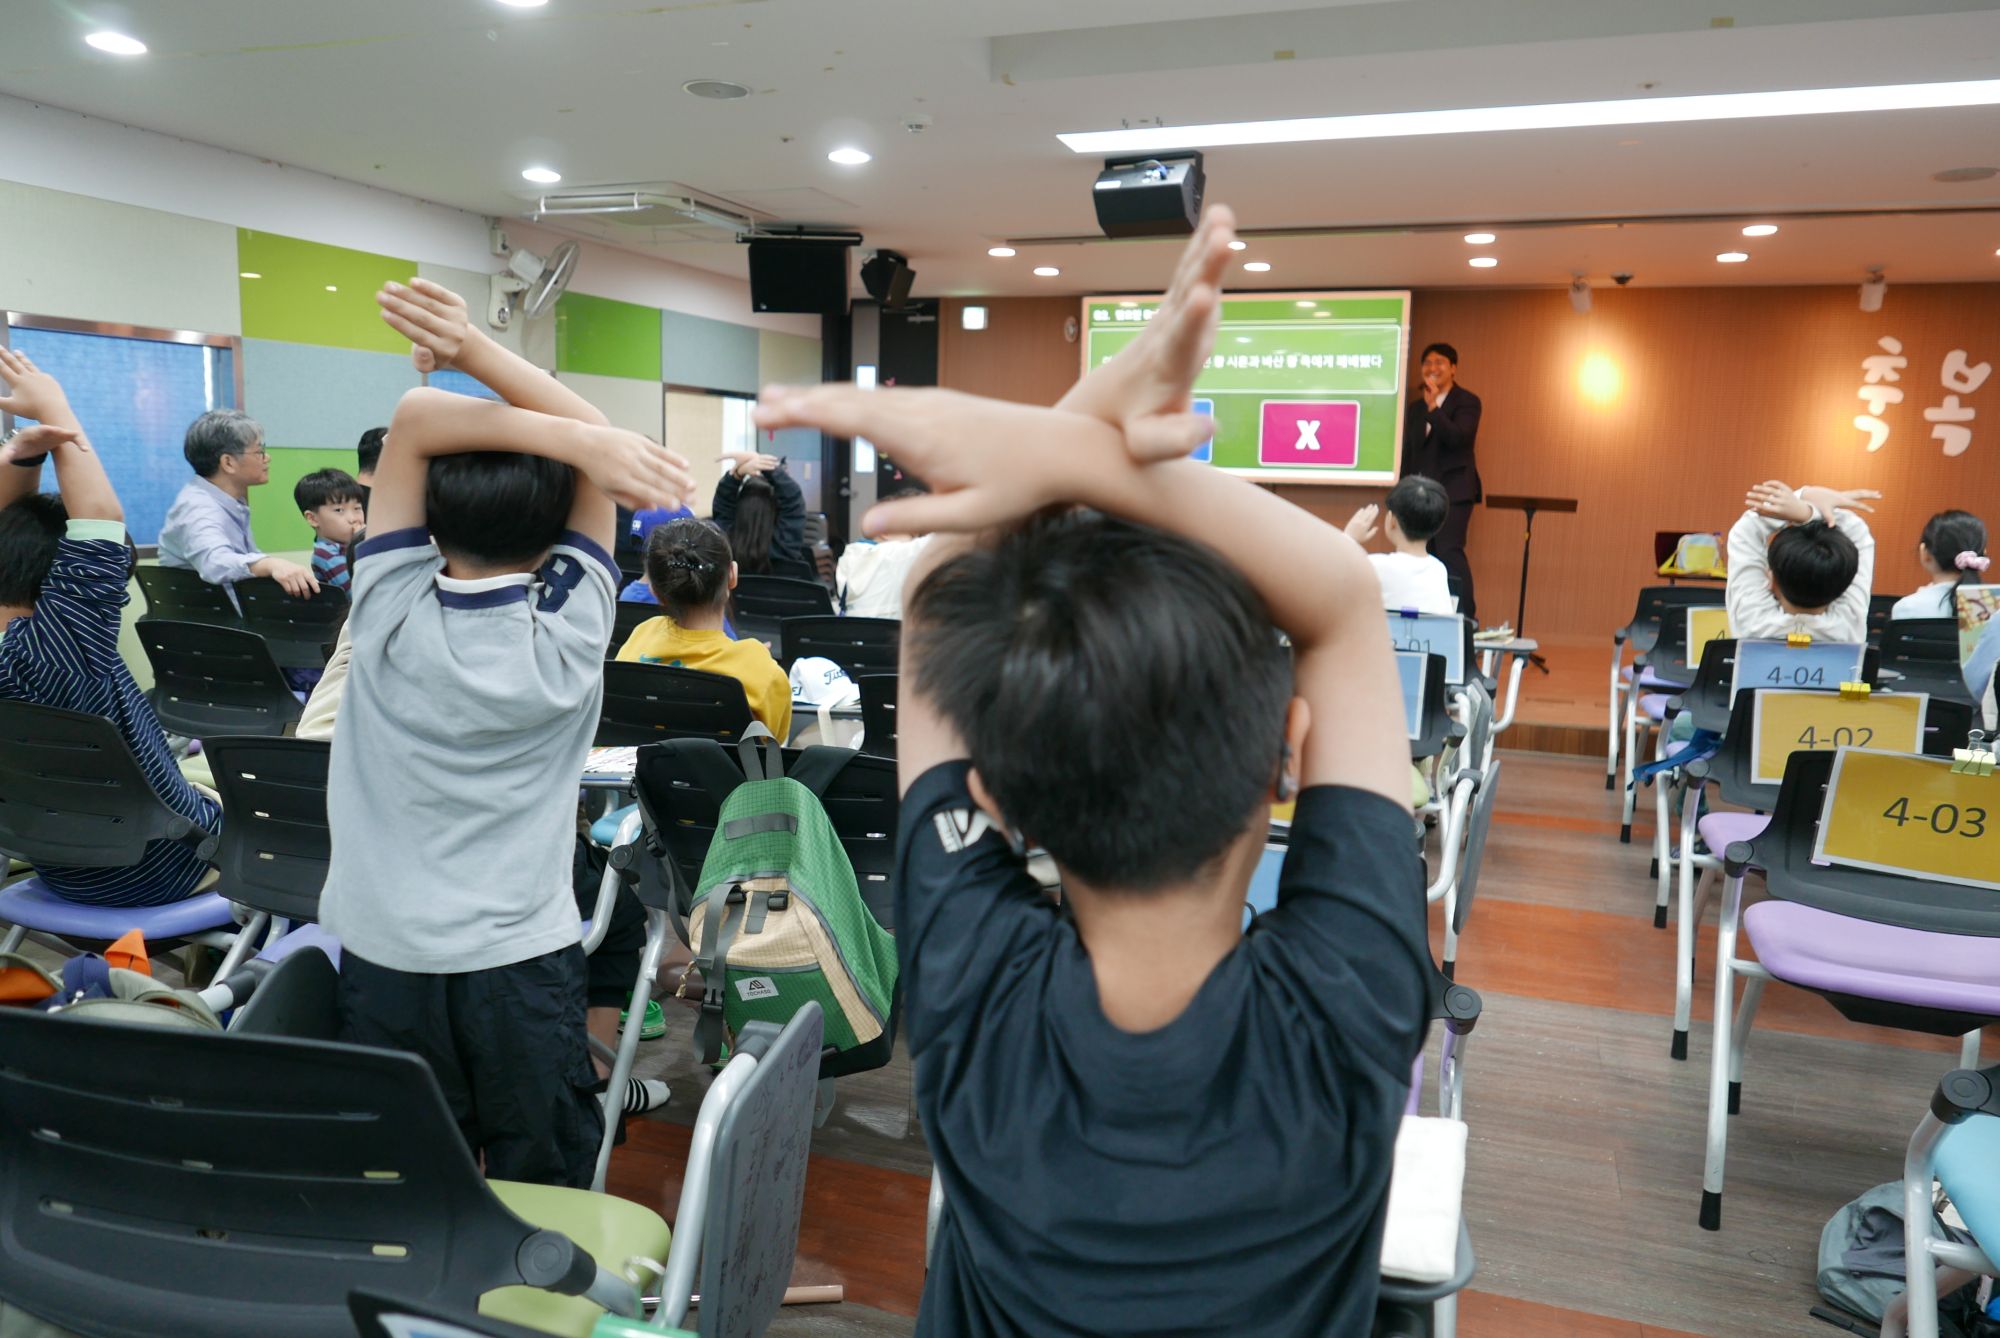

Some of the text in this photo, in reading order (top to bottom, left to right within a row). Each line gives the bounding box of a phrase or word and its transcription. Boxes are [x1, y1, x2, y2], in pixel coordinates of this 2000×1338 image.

[1295, 419, 1321, 450] X
[1766, 665, 1824, 685] 4-04
[1797, 726, 1873, 749] 4-02
[1883, 797, 1987, 838] 4-03
